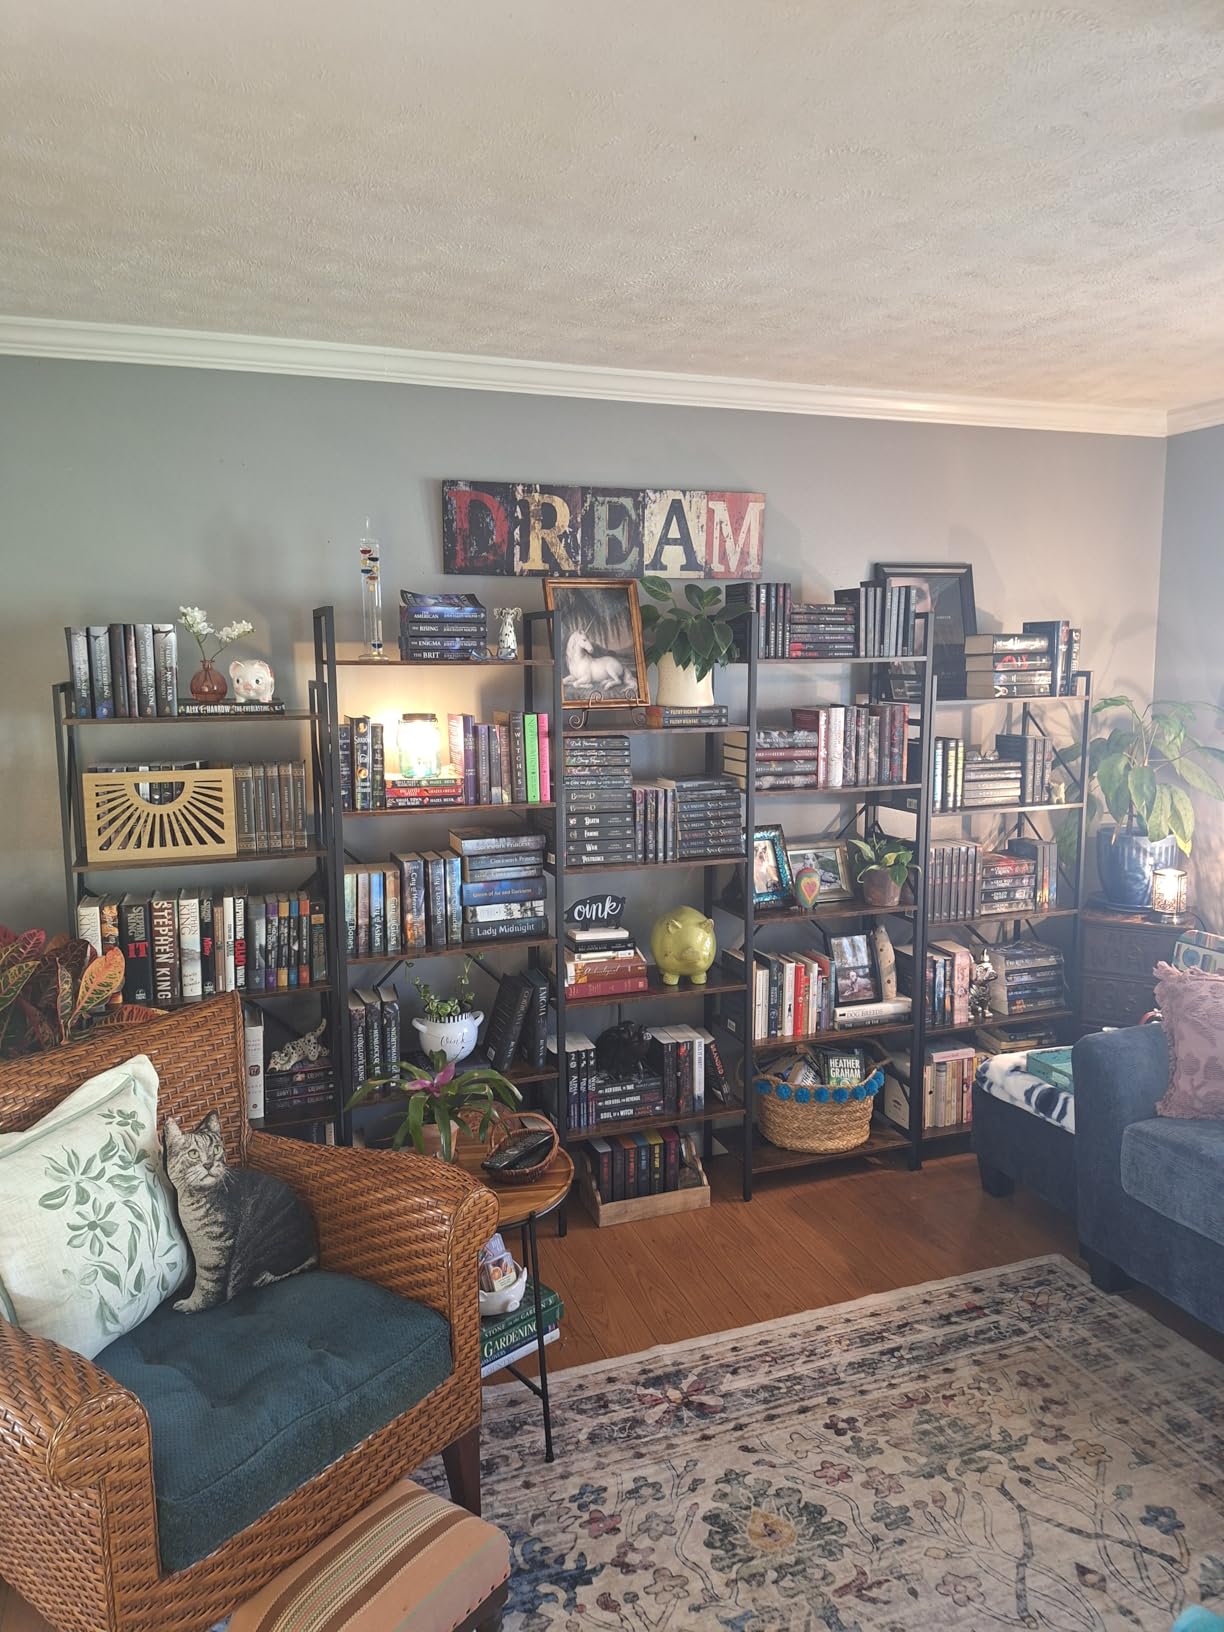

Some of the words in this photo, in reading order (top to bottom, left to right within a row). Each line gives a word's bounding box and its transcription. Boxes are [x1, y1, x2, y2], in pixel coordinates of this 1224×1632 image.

[447, 490, 765, 572] DREAM
[422, 651, 441, 659] BRIT
[207, 704, 230, 713] HARROW
[180, 903, 191, 936] KING
[189, 902, 199, 936] STEPHEN
[436, 906, 444, 925] Souls
[573, 896, 621, 921] oink
[127, 913, 137, 936] KING
[132, 906, 146, 941] STEPHEN
[153, 901, 170, 963] STEPHEN
[374, 923, 383, 947] Ashes
[390, 923, 400, 945] Glass
[476, 926, 498, 937] Lady
[498, 923, 535, 934] Midnight
[127, 941, 149, 958] IT
[234, 939, 247, 966] CUJO
[155, 966, 172, 999] KING
[538, 986, 548, 1017] ENIGMA
[357, 1065, 365, 1081] KING
[829, 1058, 861, 1069] HEATHER
[830, 1068, 861, 1079] GRAHAM
[600, 1111, 612, 1120] SOUL
[619, 1108, 634, 1117] WITCH
